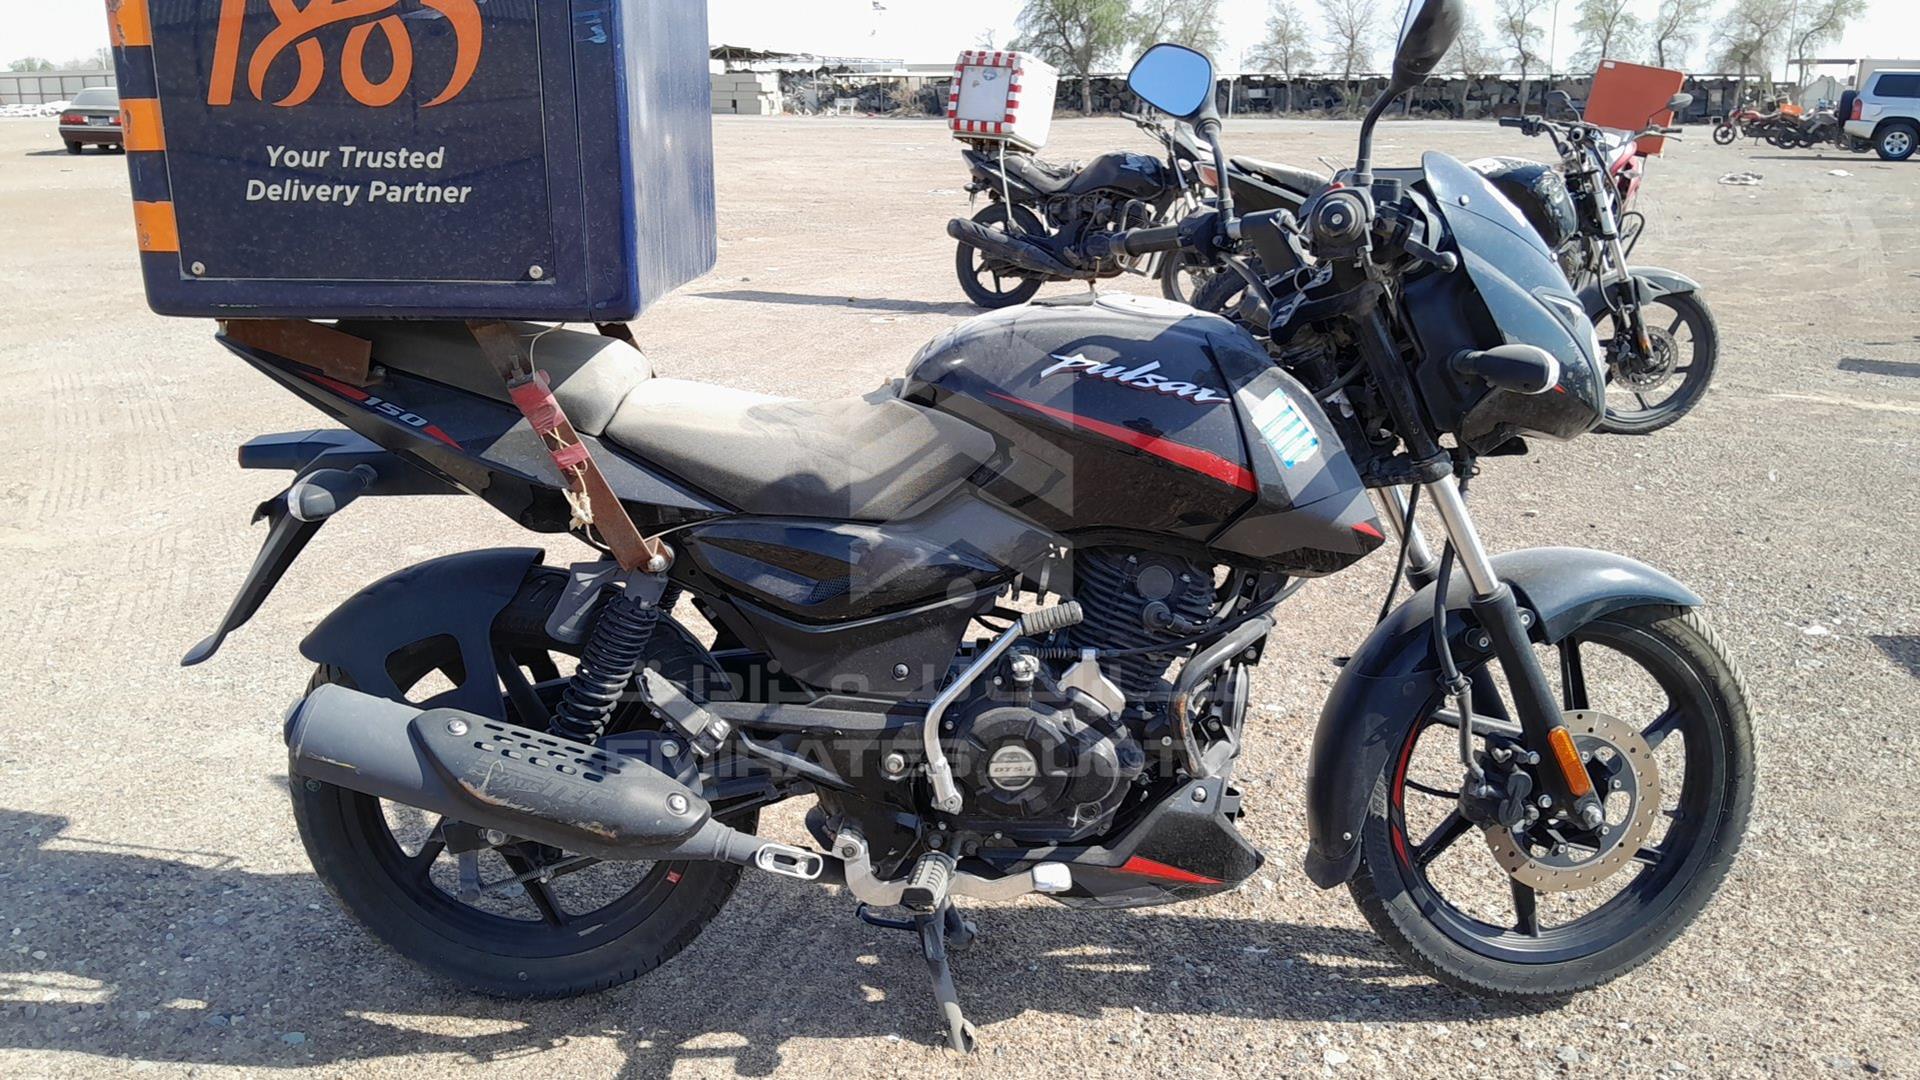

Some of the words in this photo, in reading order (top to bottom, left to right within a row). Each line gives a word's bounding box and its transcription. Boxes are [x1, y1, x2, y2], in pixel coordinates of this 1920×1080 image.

[266, 145, 330, 168] Your
[339, 146, 445, 169] Trusted
[246, 179, 359, 206] Delivery
[368, 181, 472, 203] Partner
[364, 396, 428, 427] 150
